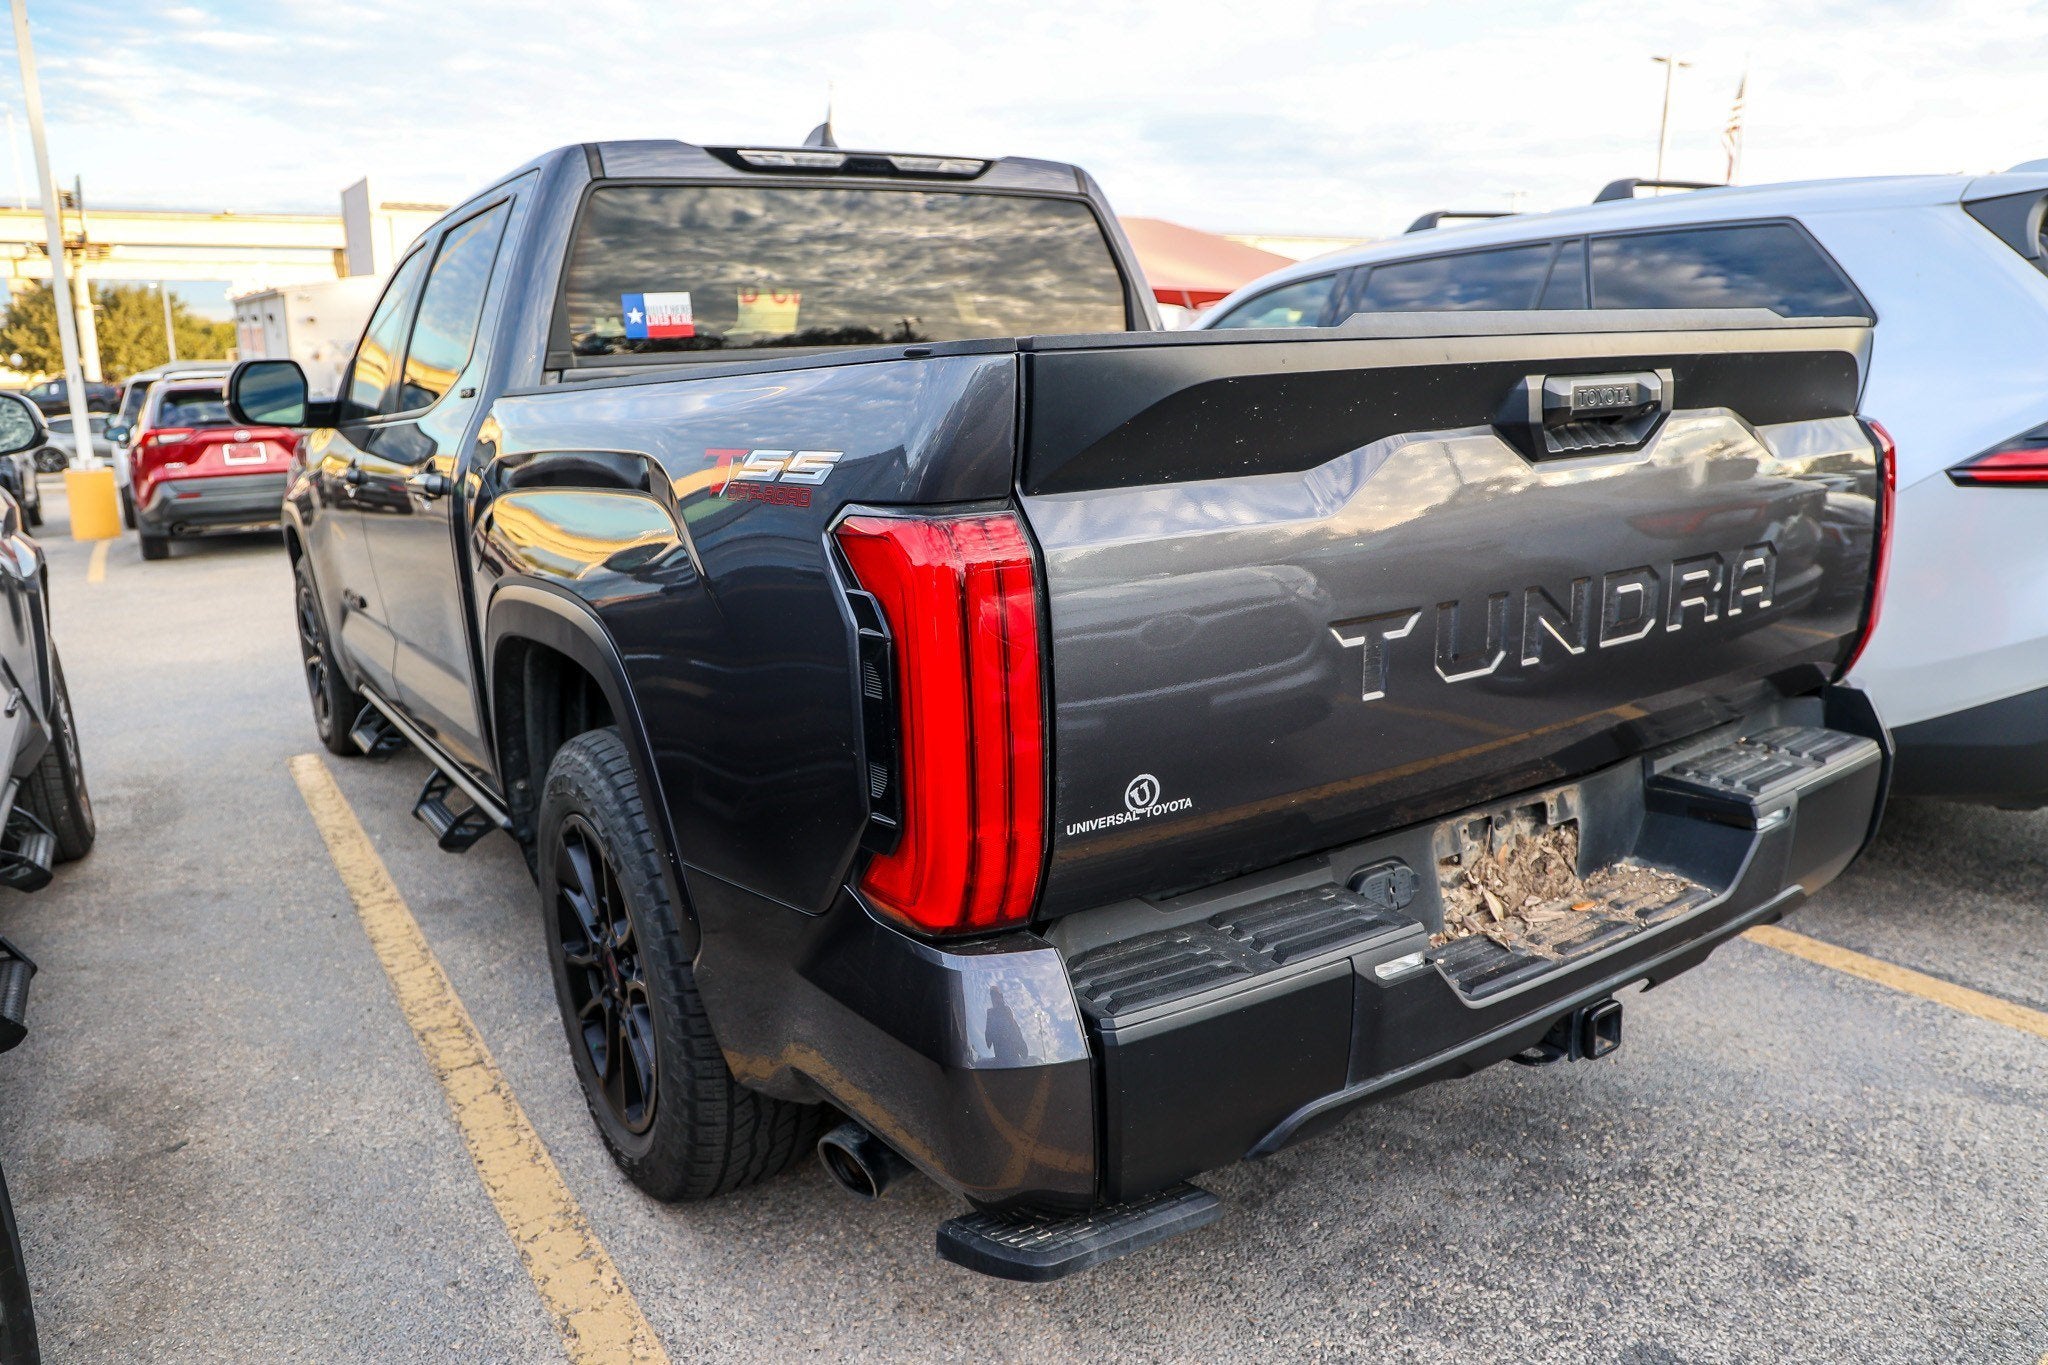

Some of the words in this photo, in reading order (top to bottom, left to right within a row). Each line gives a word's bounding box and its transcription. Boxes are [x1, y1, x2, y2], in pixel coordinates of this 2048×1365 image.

[1578, 386, 1633, 407] TOYOTA
[727, 481, 812, 508] OFF-ROAD
[1328, 540, 1778, 702] TUNDRA
[1066, 810, 1141, 836] UNIVERSAL
[1145, 797, 1193, 818] TOYOTA
